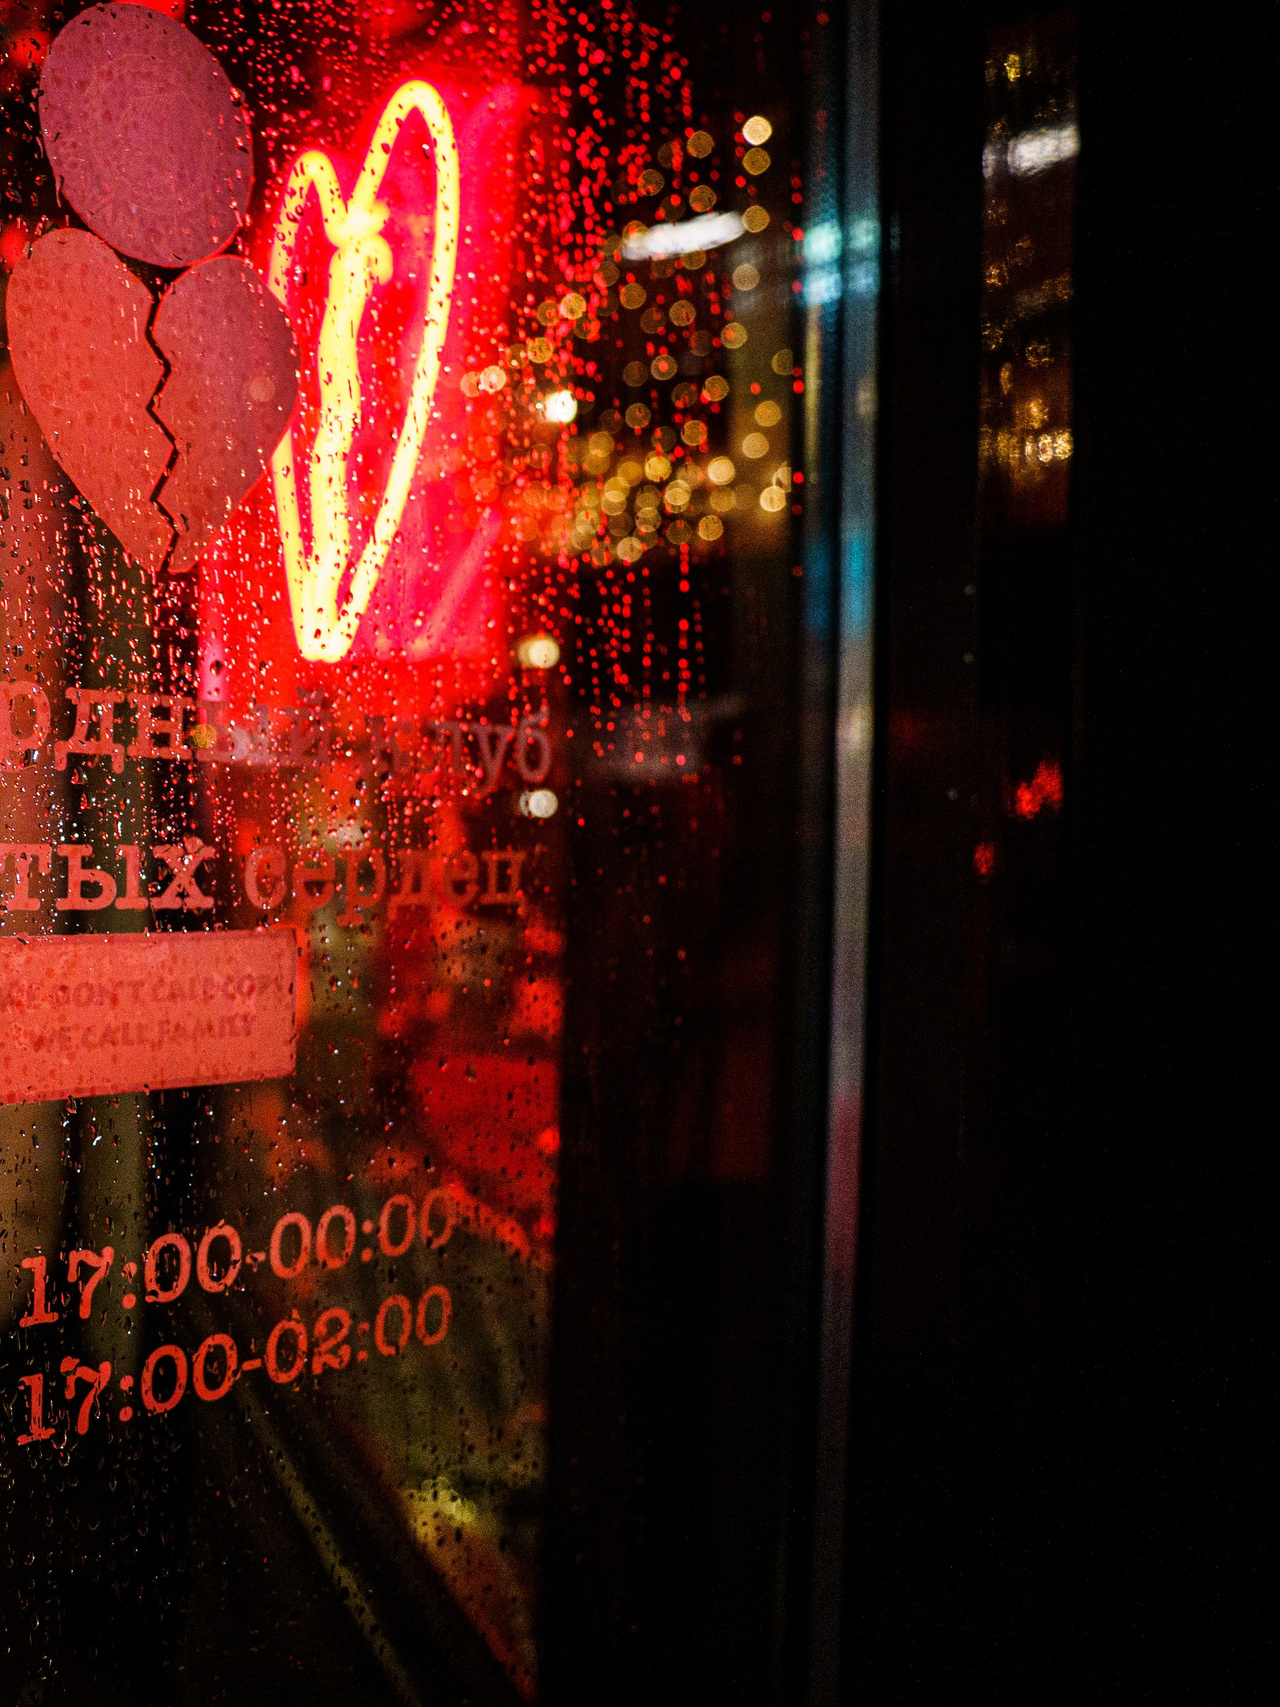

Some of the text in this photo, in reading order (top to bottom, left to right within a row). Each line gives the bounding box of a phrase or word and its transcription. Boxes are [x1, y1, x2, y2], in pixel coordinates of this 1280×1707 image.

[363, 703, 551, 794] клуб
[243, 845, 527, 926] сердец
[81, 1021, 149, 1049] CALL
[156, 1013, 257, 1044] FAMILY
[19, 1187, 455, 1328] 17:00-00:00
[16, 1285, 453, 1445] 17:00-02:00
